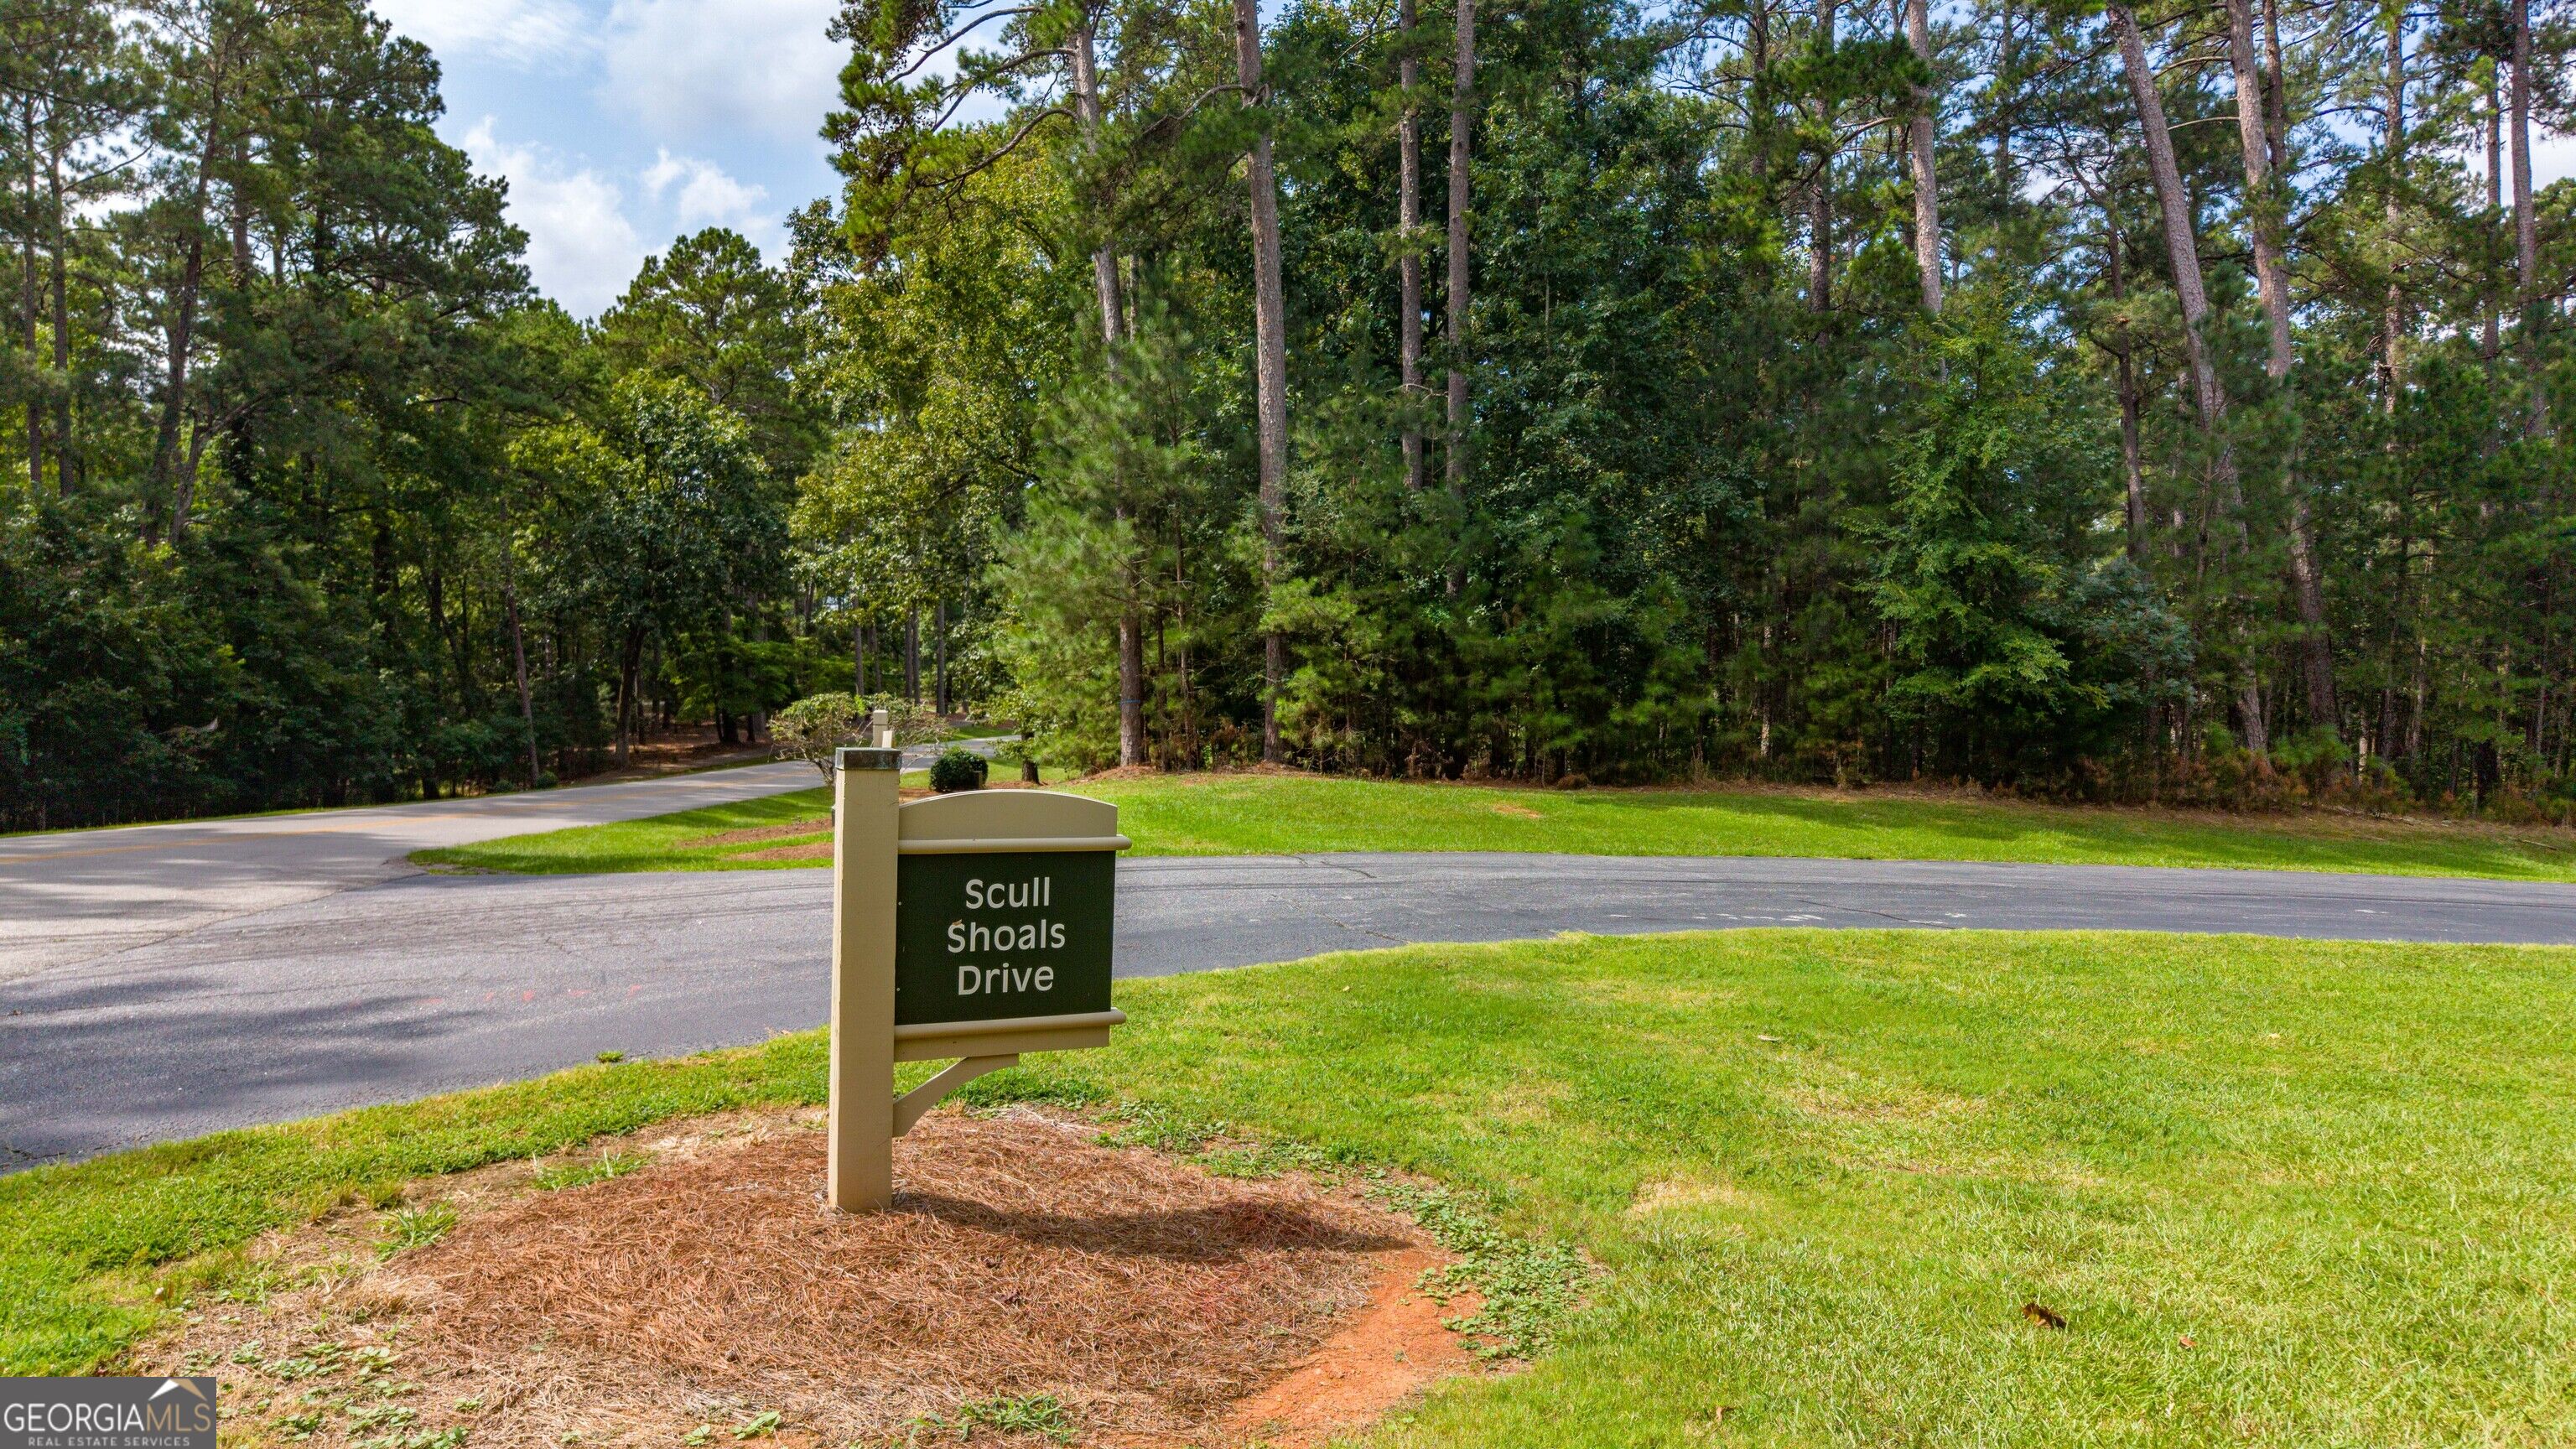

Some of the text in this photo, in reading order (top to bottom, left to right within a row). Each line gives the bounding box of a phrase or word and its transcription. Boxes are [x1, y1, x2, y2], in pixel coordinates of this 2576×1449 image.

[965, 876, 1050, 909] Scull
[948, 919, 1066, 953] Shoals
[958, 963, 1054, 995] Drive
